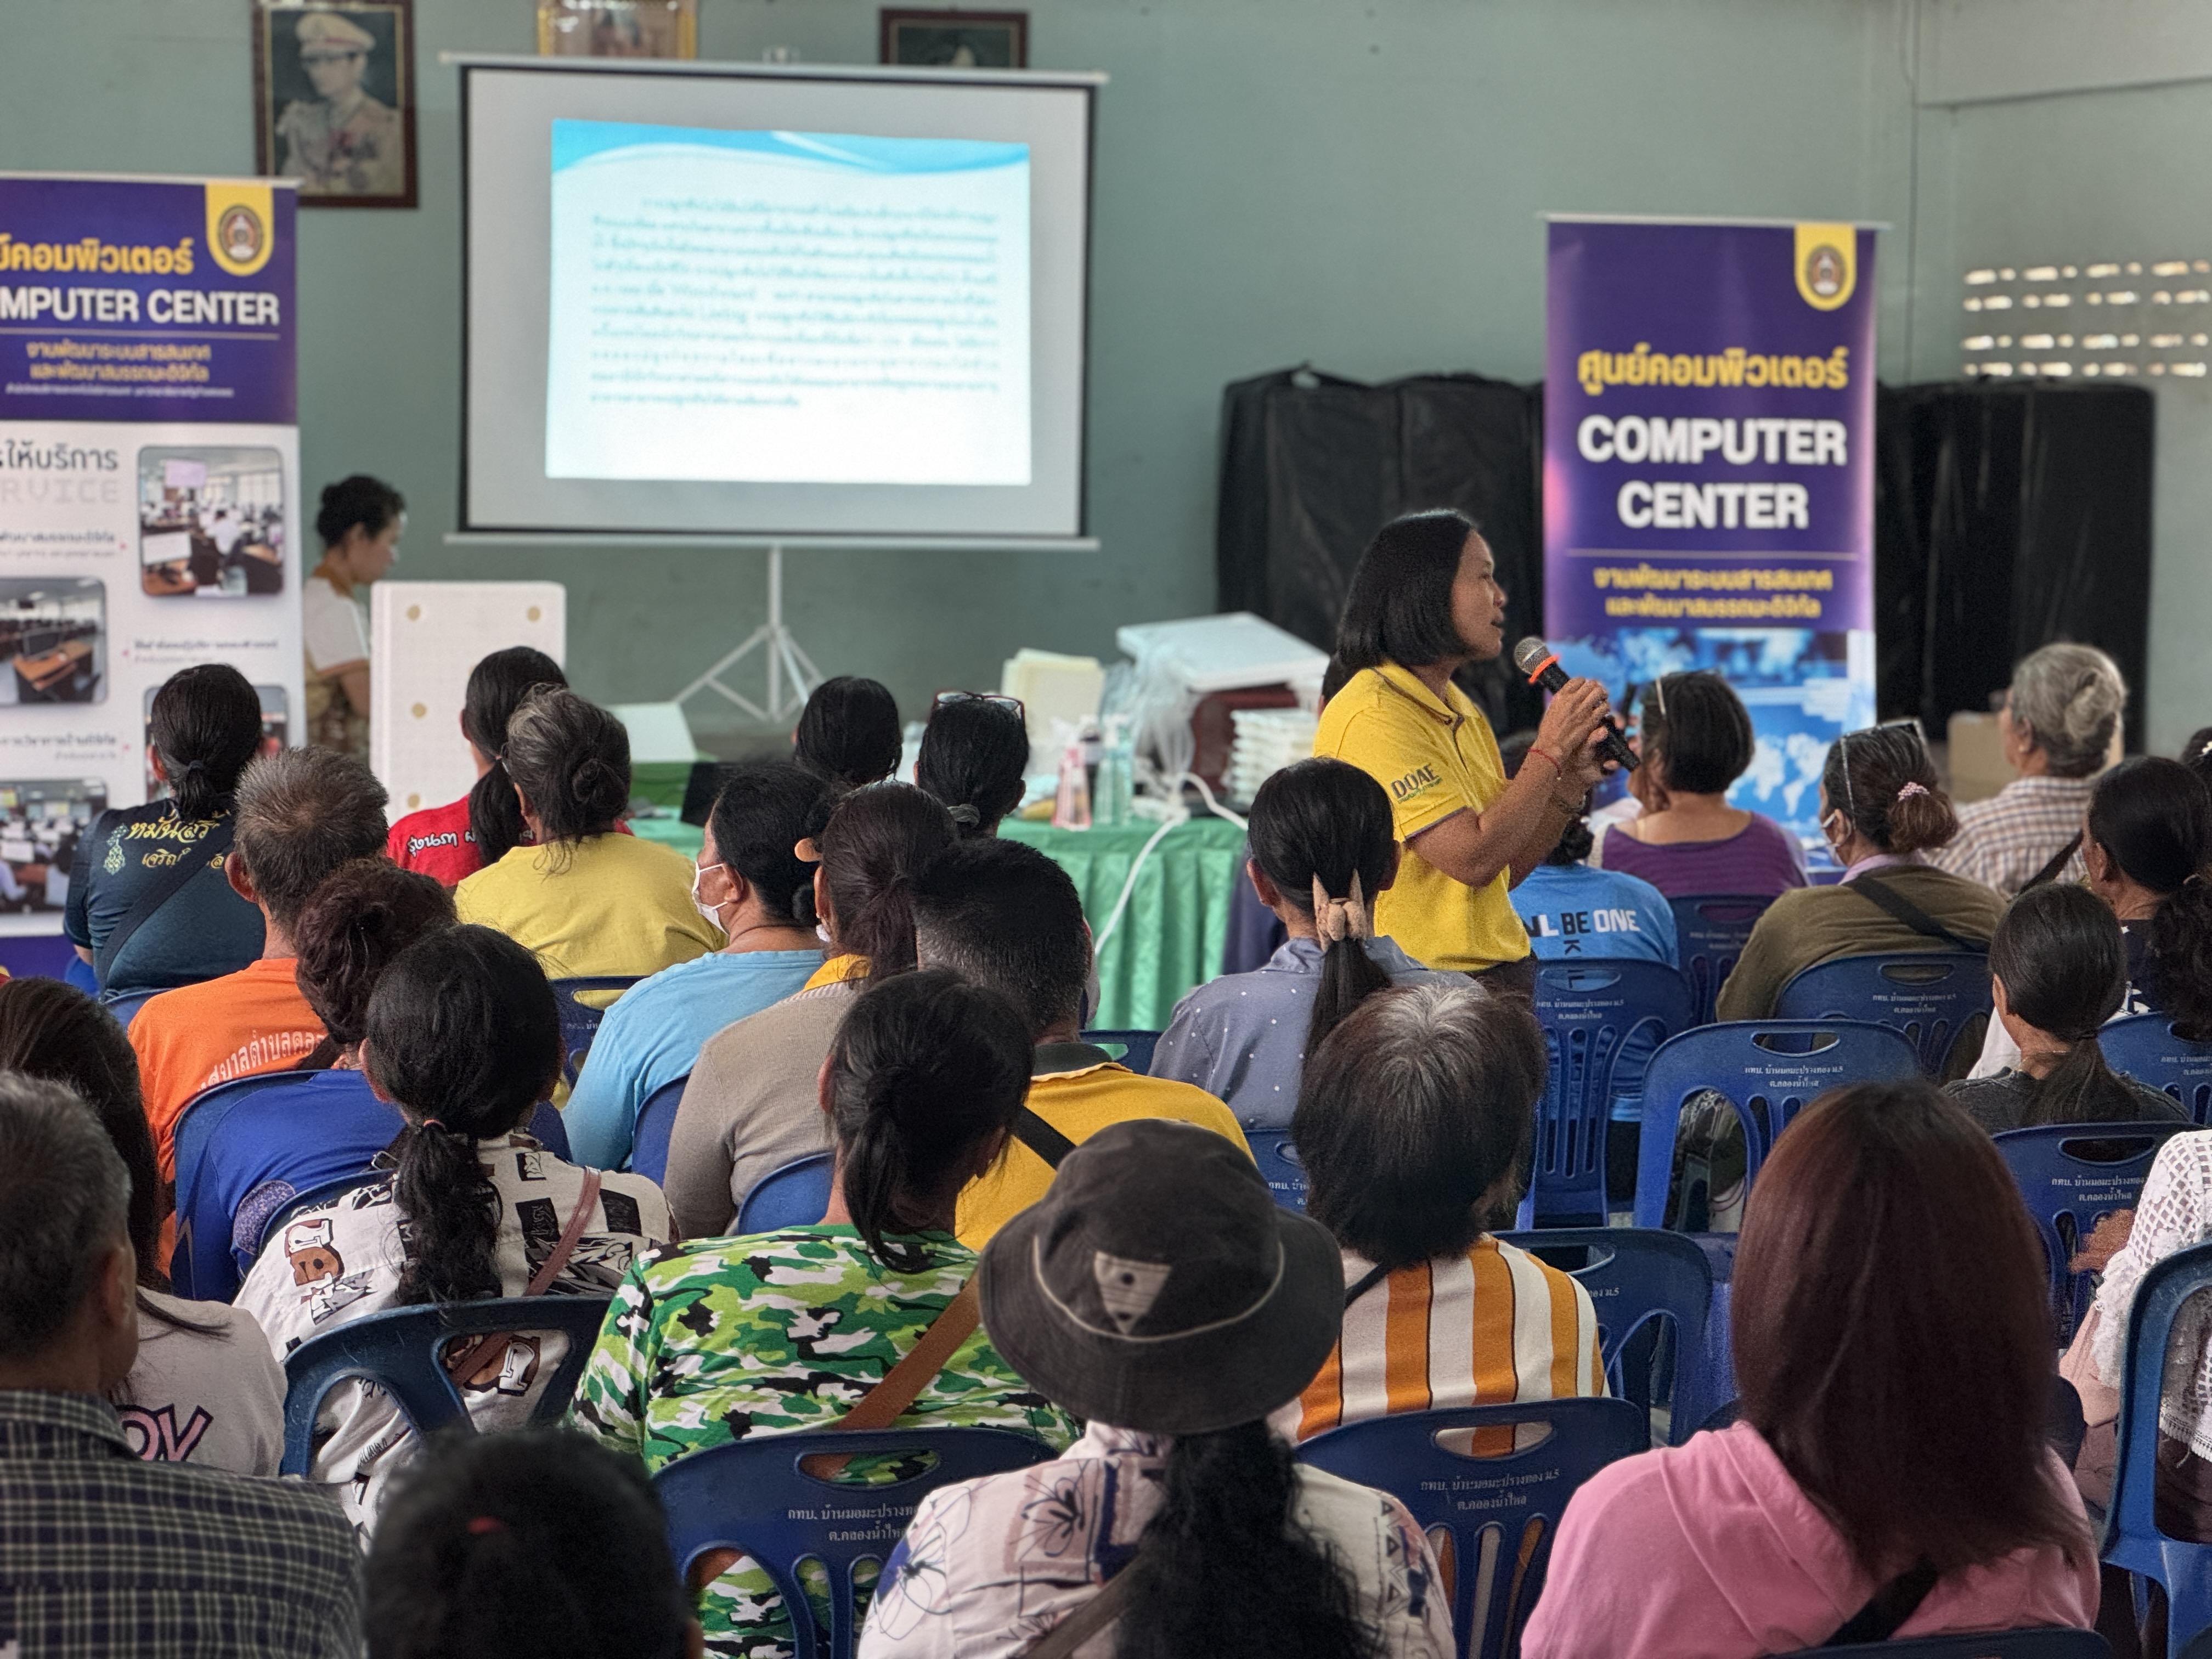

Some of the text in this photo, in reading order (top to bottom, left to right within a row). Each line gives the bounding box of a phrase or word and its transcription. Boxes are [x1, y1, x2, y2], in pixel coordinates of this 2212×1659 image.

[147, 290, 279, 325] CENTER
[1578, 342, 1849, 396] ศูนย์คอมพิวเตอร์
[0, 438, 119, 471] ให้บริการ
[1578, 414, 1848, 465] COMPUTER
[1617, 480, 1809, 529] CENTER
[1561, 911, 1590, 935] BE
[1593, 909, 1640, 932] ONE
